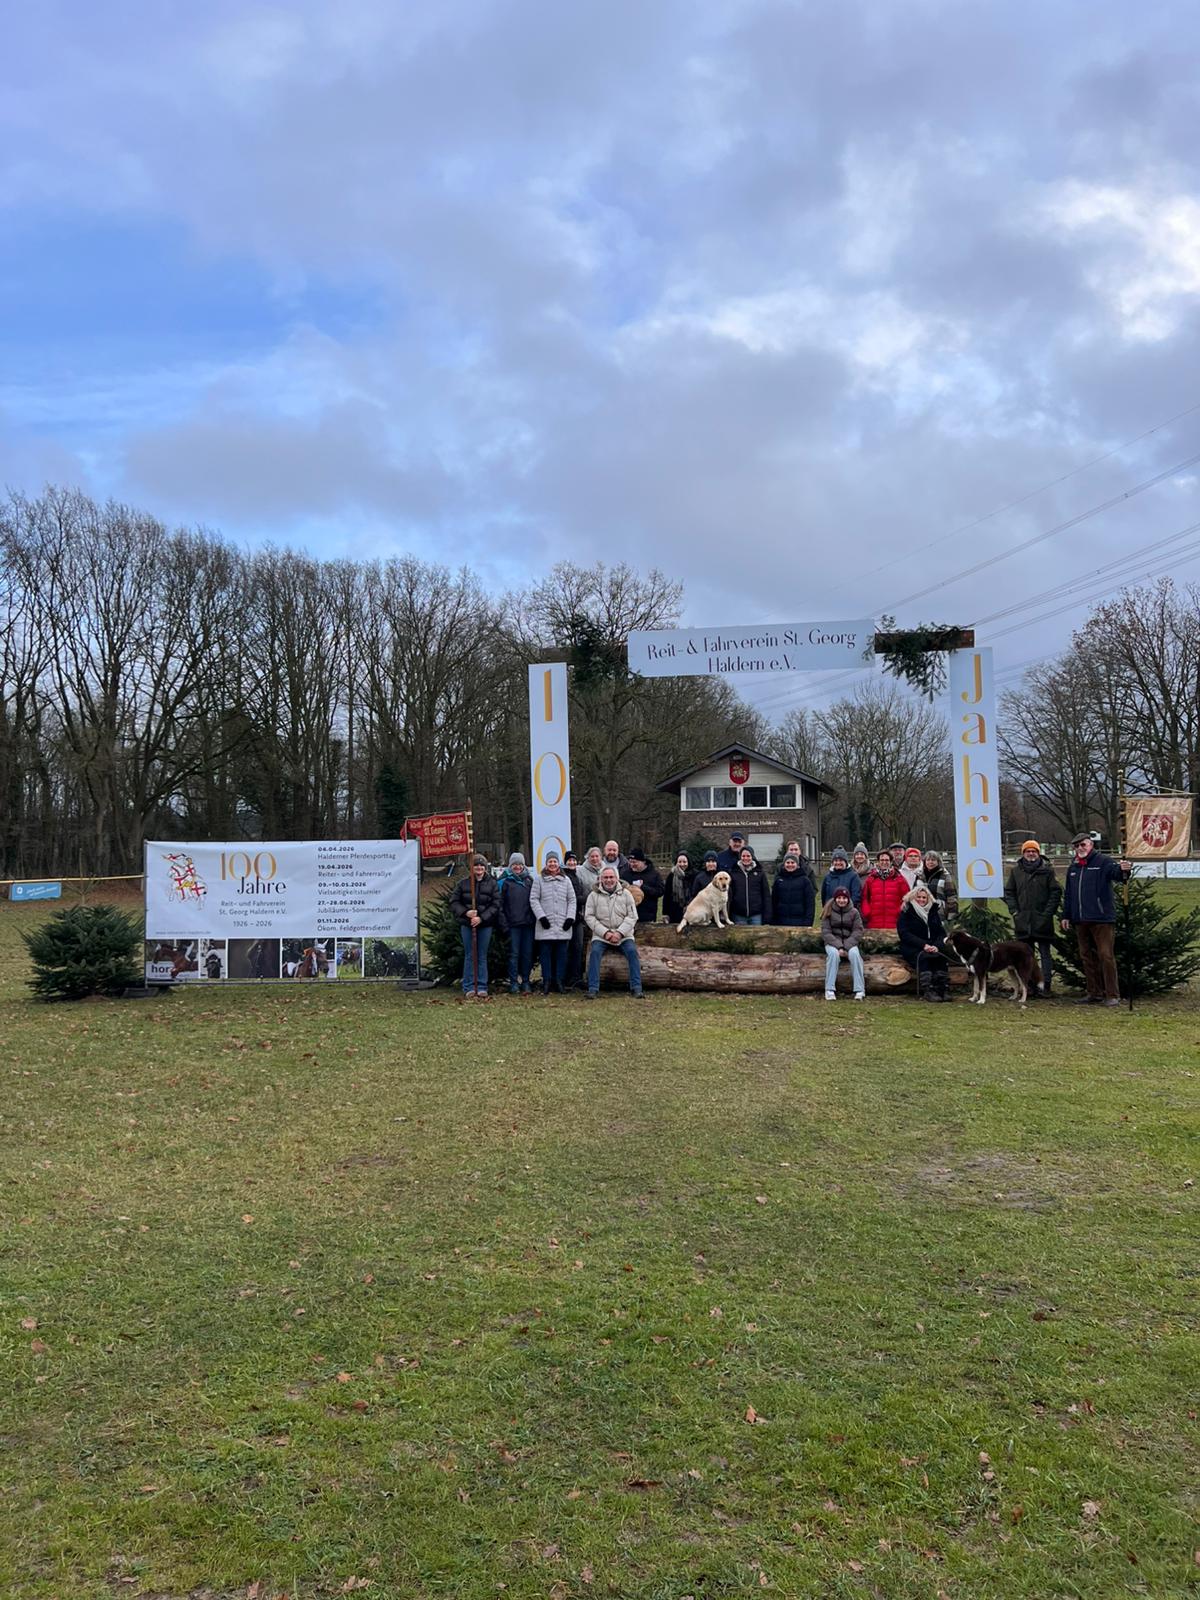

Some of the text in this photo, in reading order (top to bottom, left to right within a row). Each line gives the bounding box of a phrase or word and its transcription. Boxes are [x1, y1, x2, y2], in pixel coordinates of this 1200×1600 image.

[686, 639, 699, 655] &
[703, 632, 778, 653] Fahrverein
[783, 630, 804, 646] St.
[808, 628, 857, 649] Georg
[708, 654, 797, 673] Haldern e.V.
[960, 653, 995, 892] Jahre
[221, 851, 277, 881] 100
[237, 875, 287, 895] Jahre
[318, 888, 382, 896] Vielseitigkeitsturnier
[340, 924, 391, 932] Feldgottesdienst
